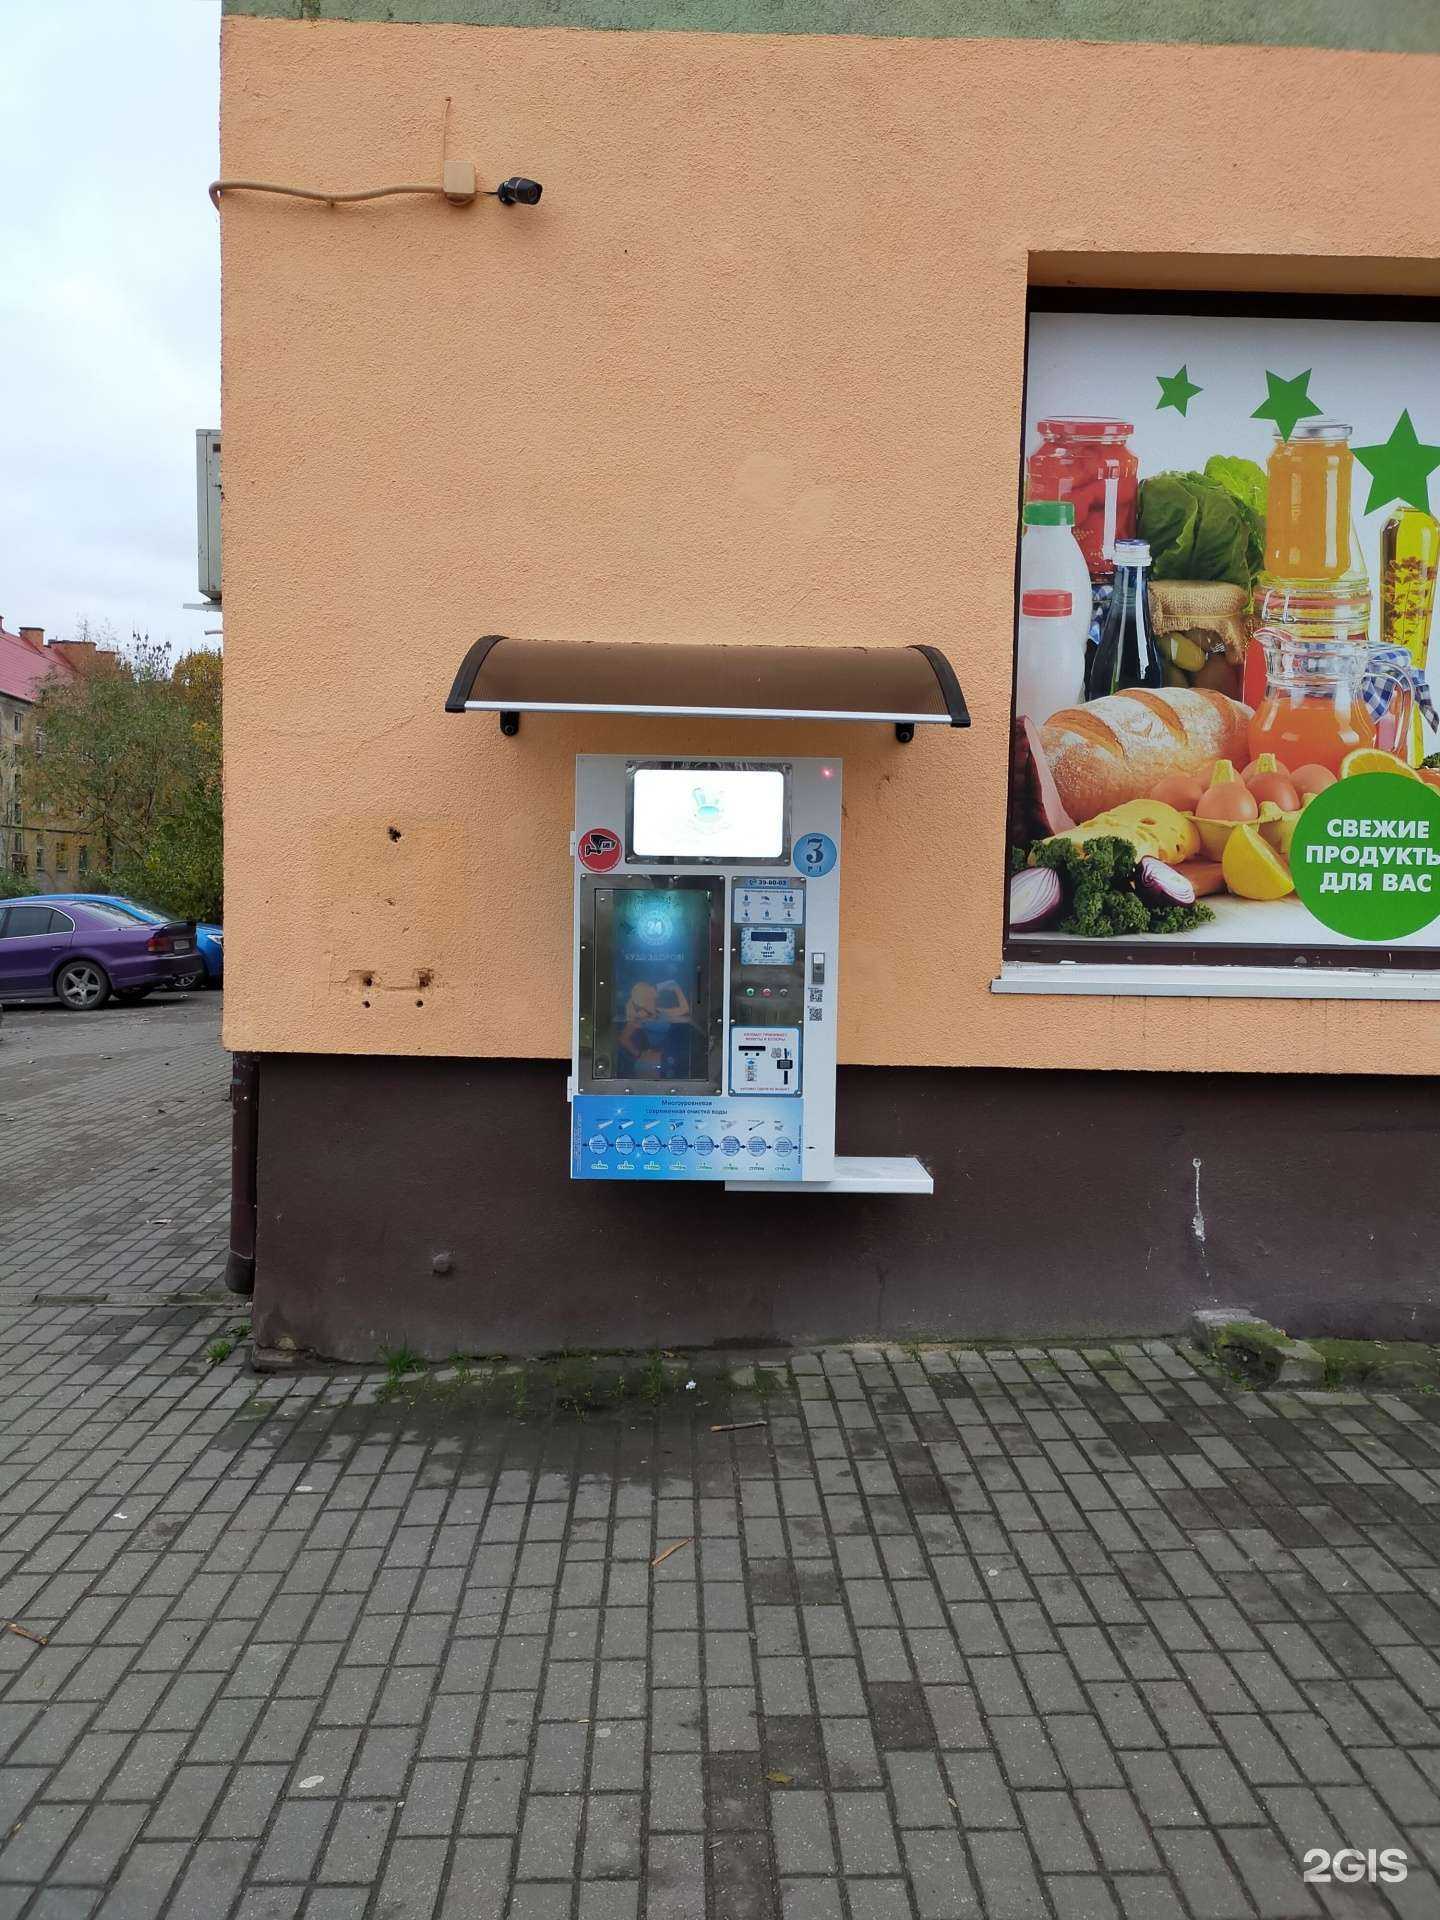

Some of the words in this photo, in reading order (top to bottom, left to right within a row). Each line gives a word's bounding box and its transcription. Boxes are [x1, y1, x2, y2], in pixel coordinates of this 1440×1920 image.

[1326, 819, 1430, 839] СВЕЖИЕ
[806, 838, 824, 864] 3
[1319, 872, 1373, 894] ДЛЯ
[1382, 873, 1432, 893] ВАС
